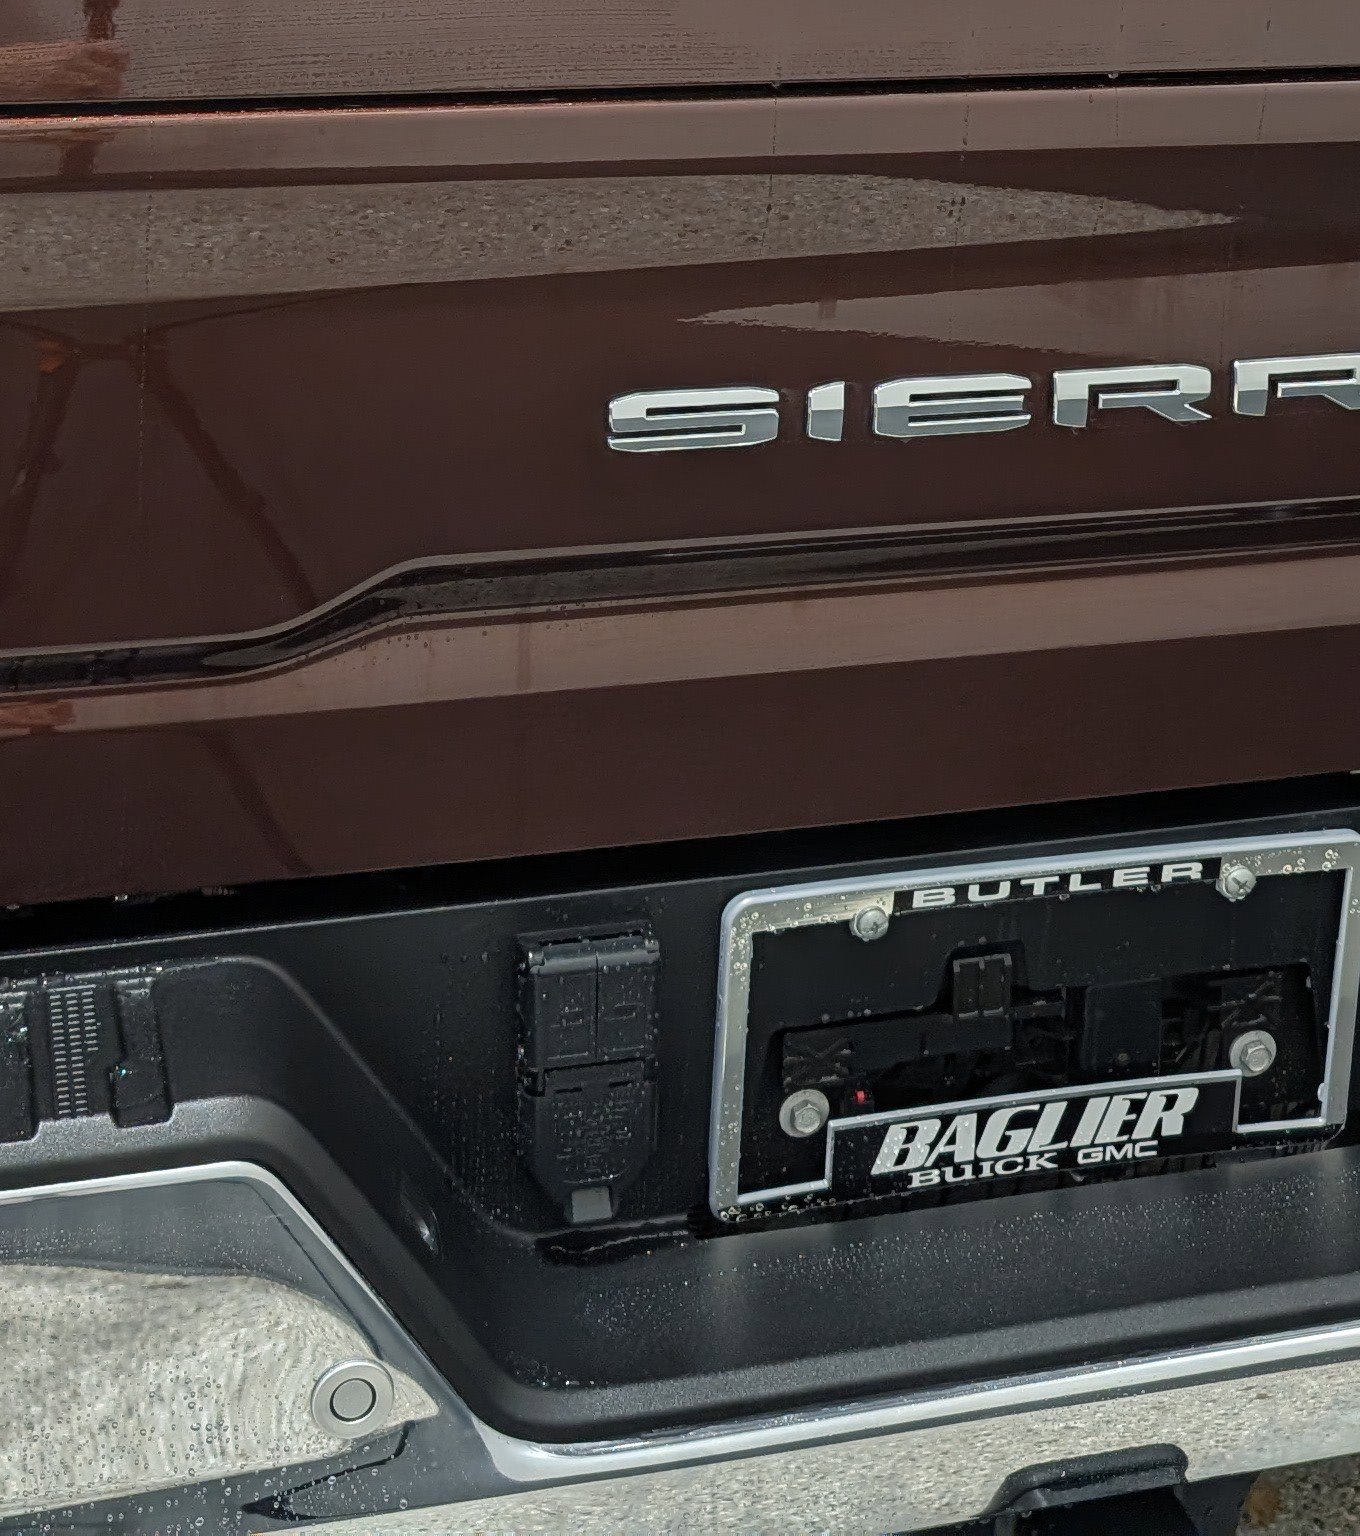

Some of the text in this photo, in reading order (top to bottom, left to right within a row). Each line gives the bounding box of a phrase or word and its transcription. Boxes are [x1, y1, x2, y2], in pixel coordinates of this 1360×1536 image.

[911, 861, 1204, 909] BUTLER
[870, 1087, 1200, 1175] BAGLIER
[907, 1139, 1159, 1190] BUICK GMC
